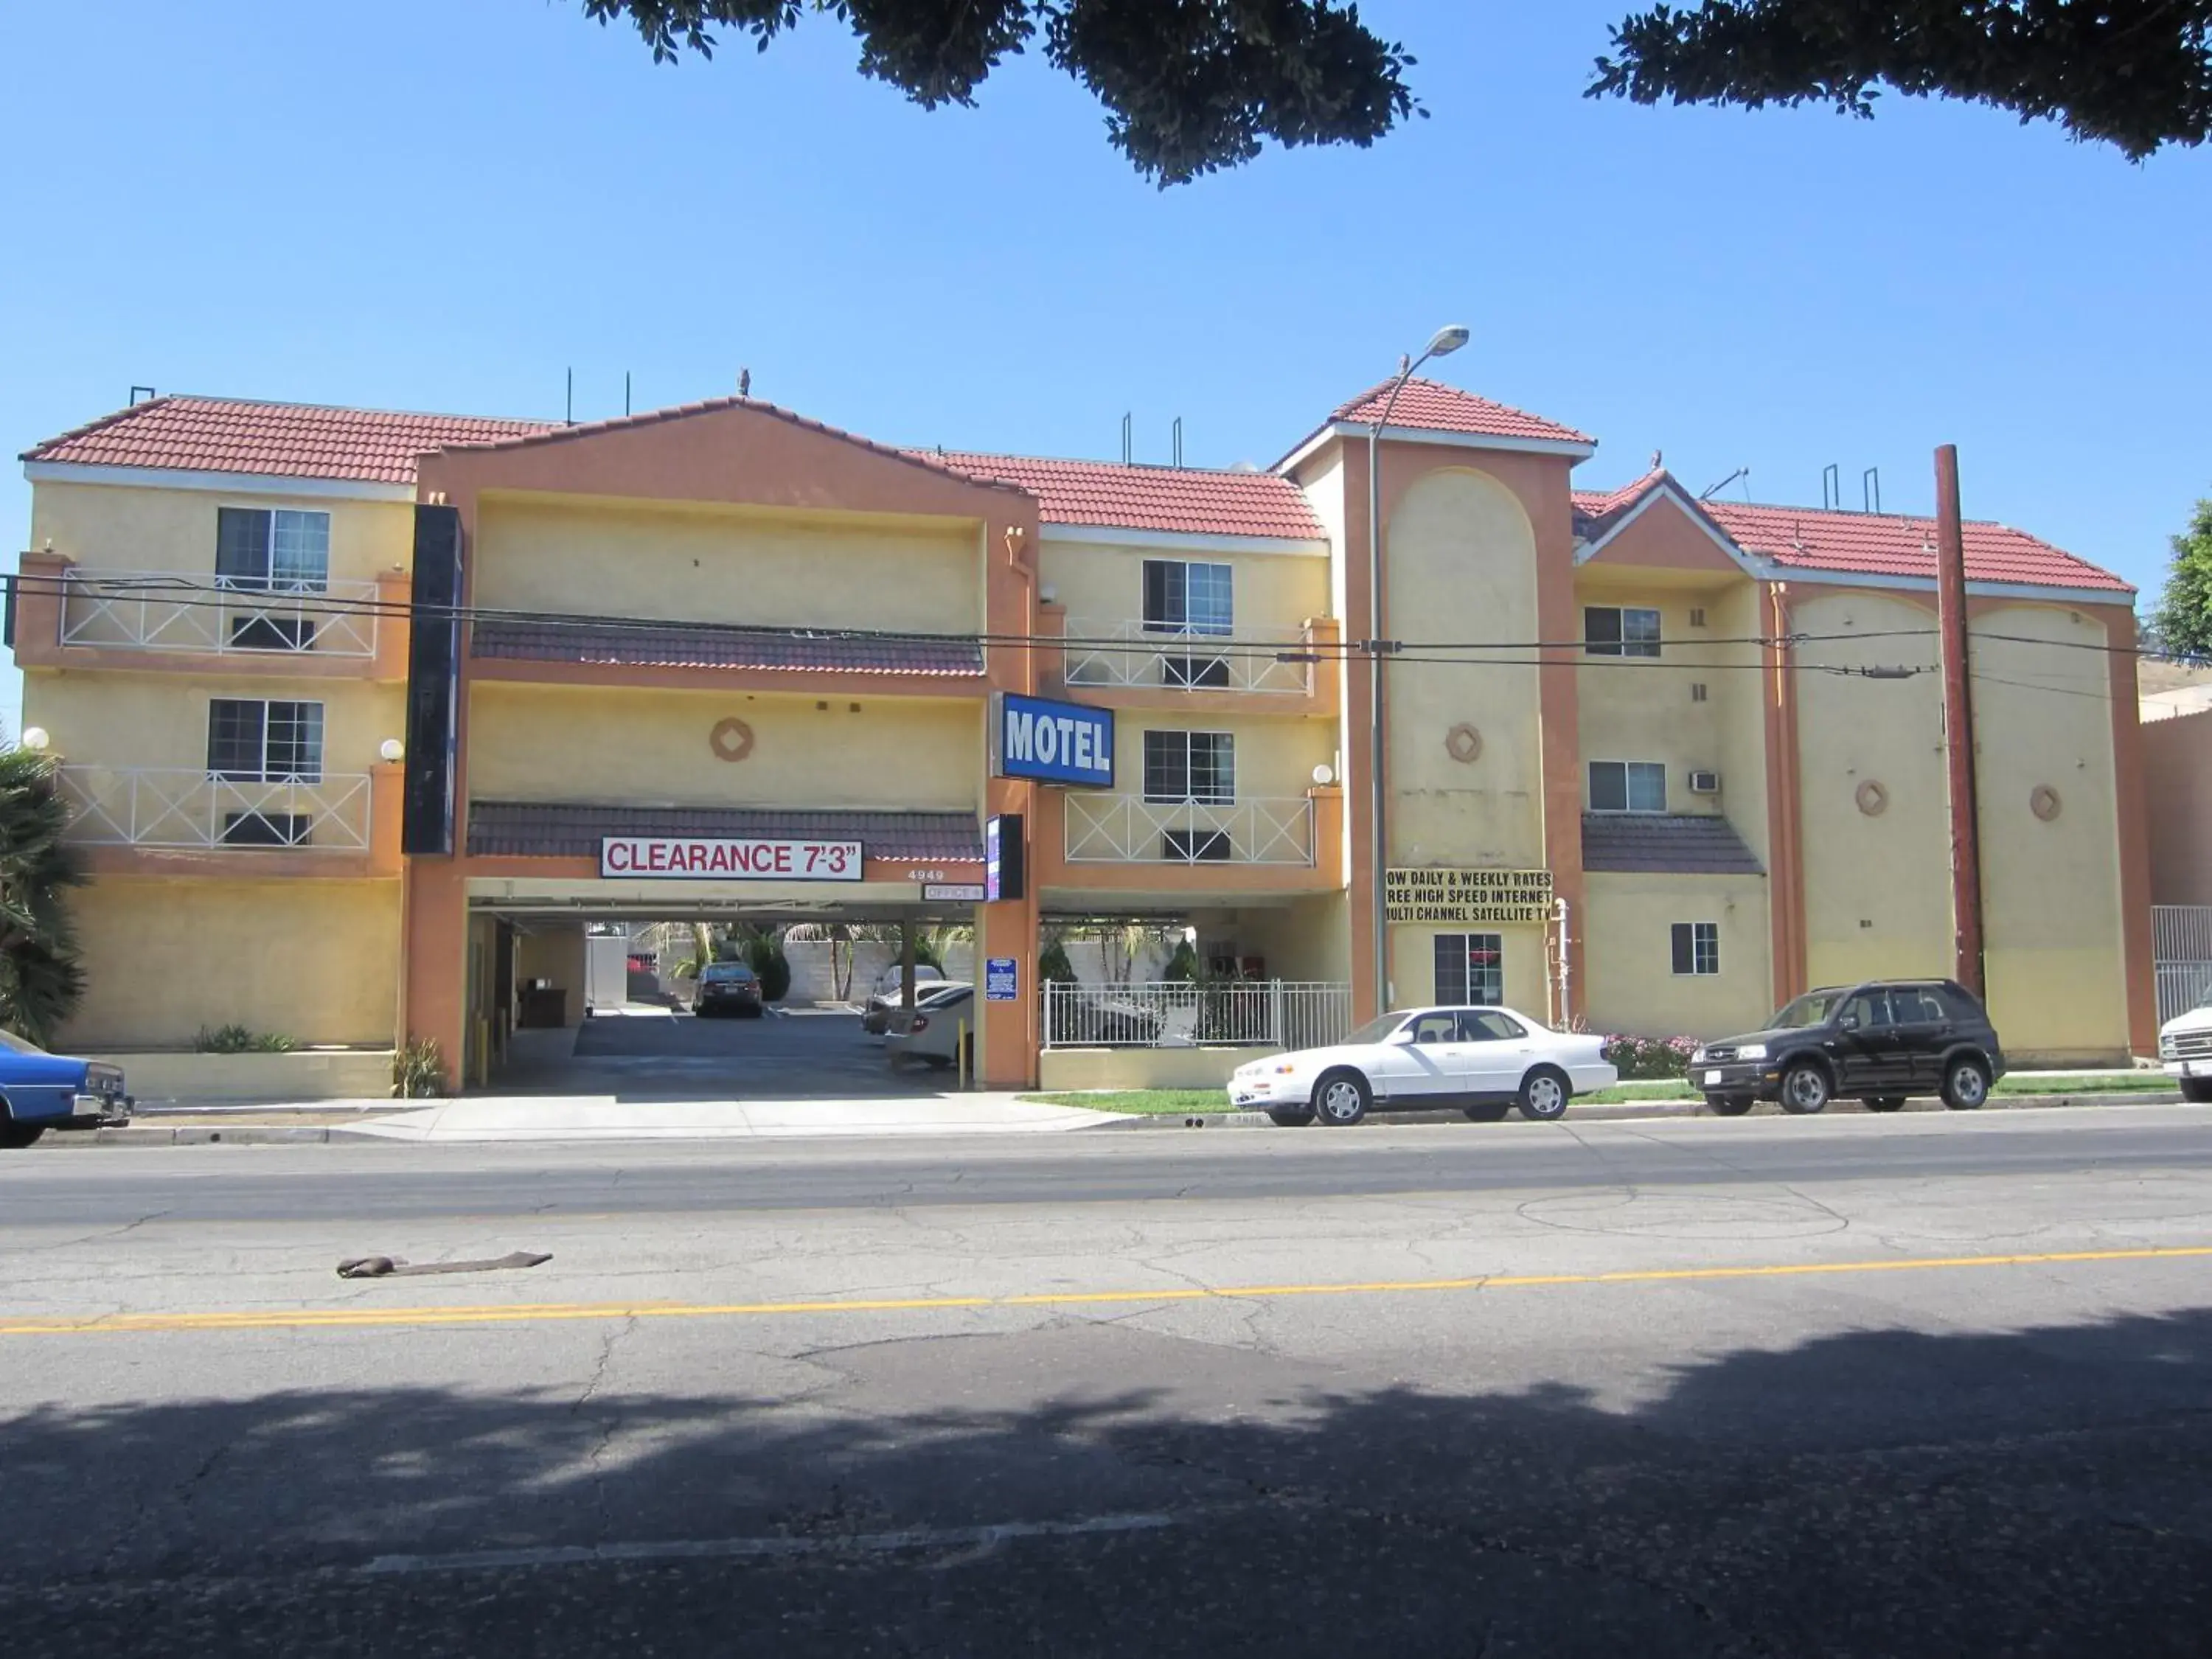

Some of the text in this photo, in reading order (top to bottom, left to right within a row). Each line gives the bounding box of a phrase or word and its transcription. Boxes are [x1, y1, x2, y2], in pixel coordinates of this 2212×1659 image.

[1007, 710, 1110, 771] MOTEL
[607, 842, 792, 873] CLEARANCE
[908, 869, 945, 881] 4949
[1411, 872, 1443, 886] DAILY
[1448, 872, 1456, 886] &
[1461, 872, 1509, 886] WEEKLY
[1513, 872, 1551, 887] RATES
[1415, 889, 1444, 902] HIGH
[1448, 889, 1487, 903] SPEED
[1492, 890, 1551, 903] INTERNET
[1416, 907, 1467, 921] CHANNEL
[1472, 907, 1532, 921] SATELLITE
[1537, 908, 1551, 921] TV
